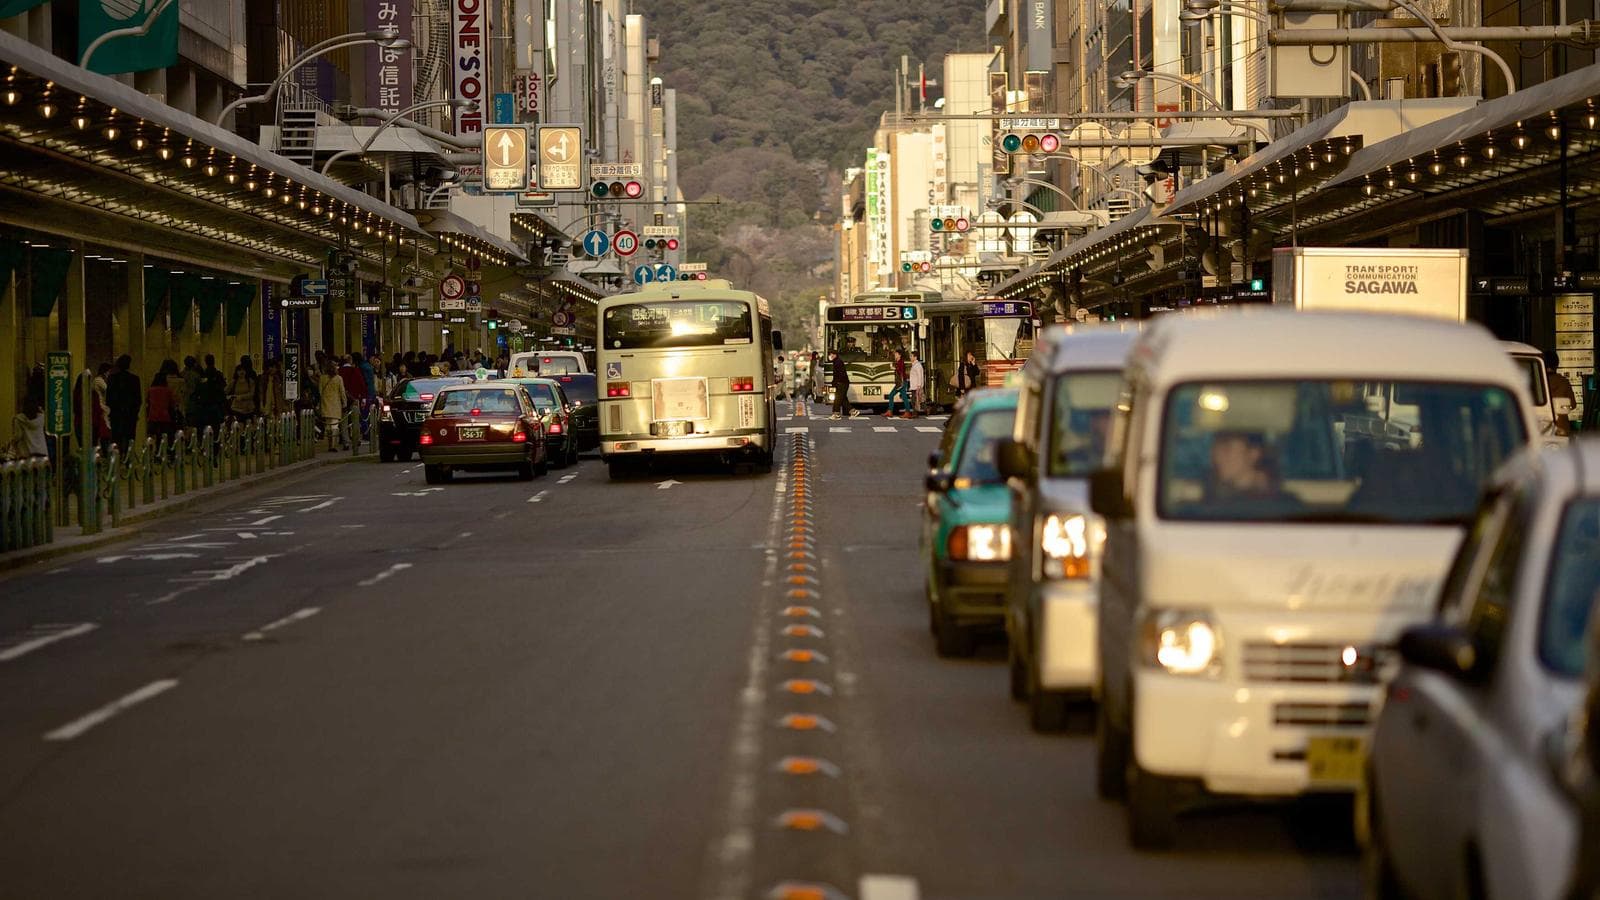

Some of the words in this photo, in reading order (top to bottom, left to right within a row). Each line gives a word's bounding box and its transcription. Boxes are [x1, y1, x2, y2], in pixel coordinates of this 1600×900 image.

[1033, 2, 1045, 30] BANK
[878, 172, 888, 266] TAKASHIMAYA
[619, 237, 633, 249] 40
[1344, 280, 1419, 294] SAGAWA
[885, 307, 898, 318] 5
[49, 356, 69, 365] TAXI
